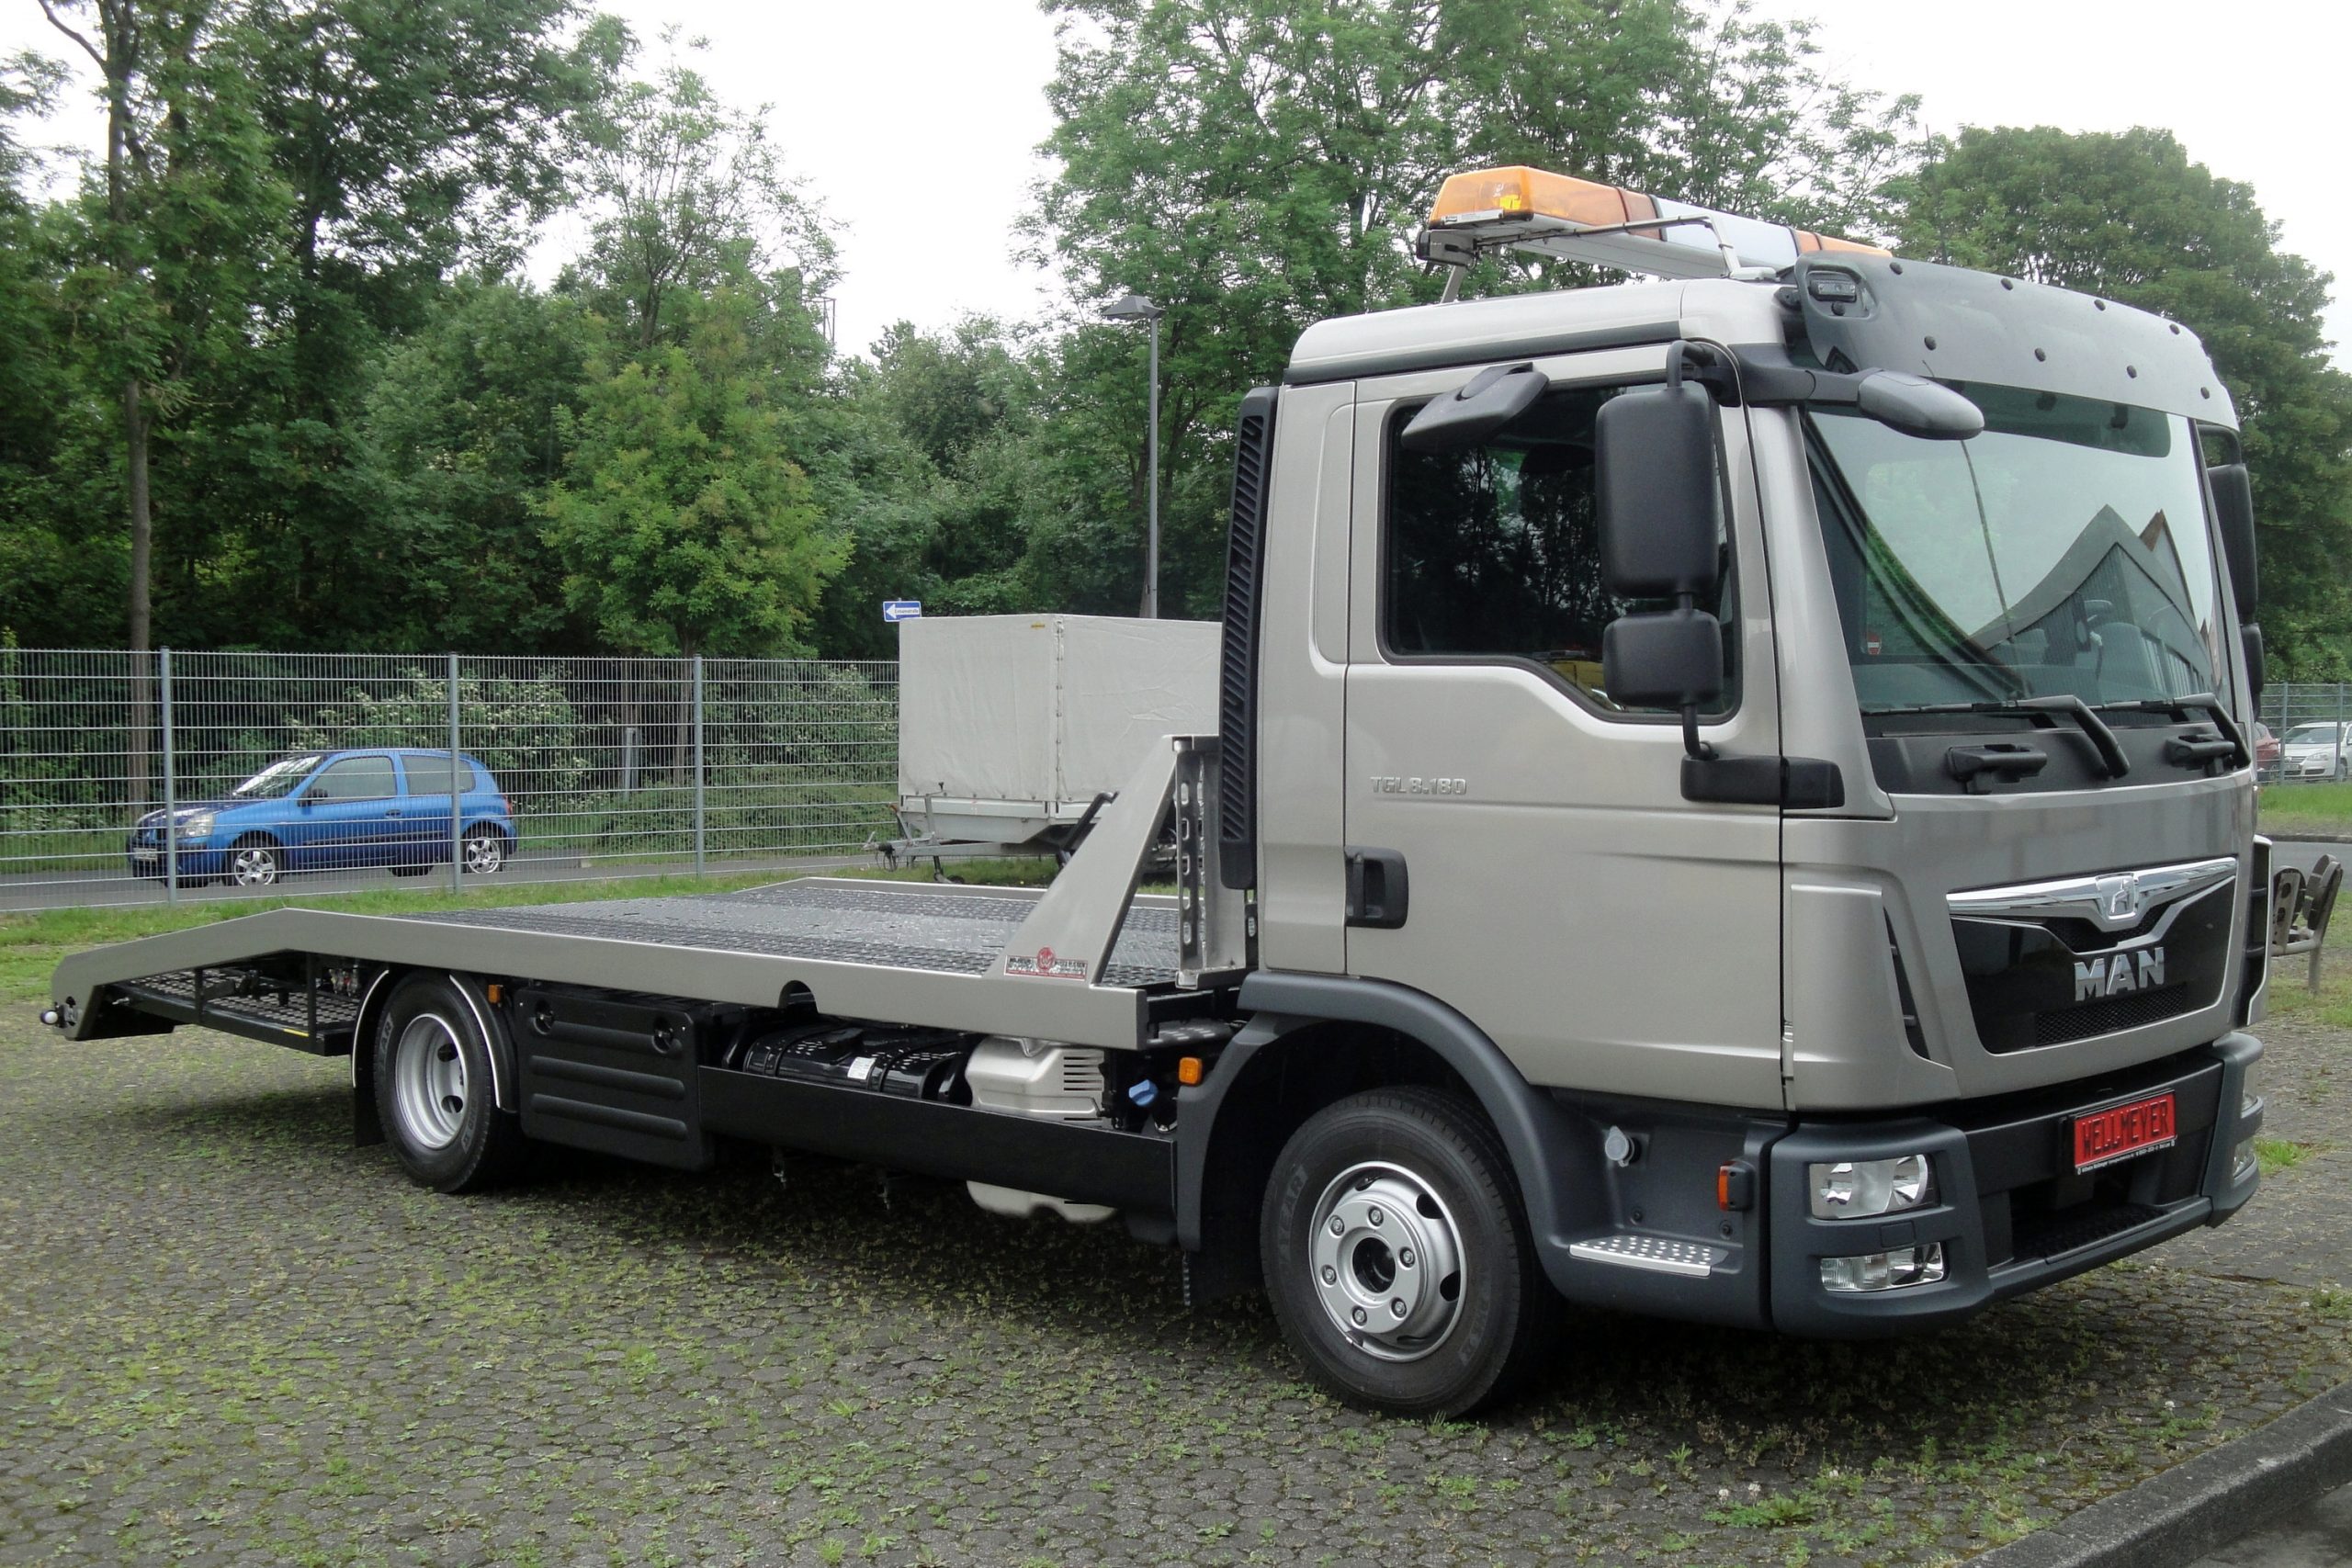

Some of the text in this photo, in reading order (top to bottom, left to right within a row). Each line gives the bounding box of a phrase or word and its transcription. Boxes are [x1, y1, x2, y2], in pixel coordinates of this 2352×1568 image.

[1370, 776, 1467, 795] TGL 8.180
[2074, 946, 2165, 1001] MAN
[2082, 1099, 2169, 1159] WELLMEYER
